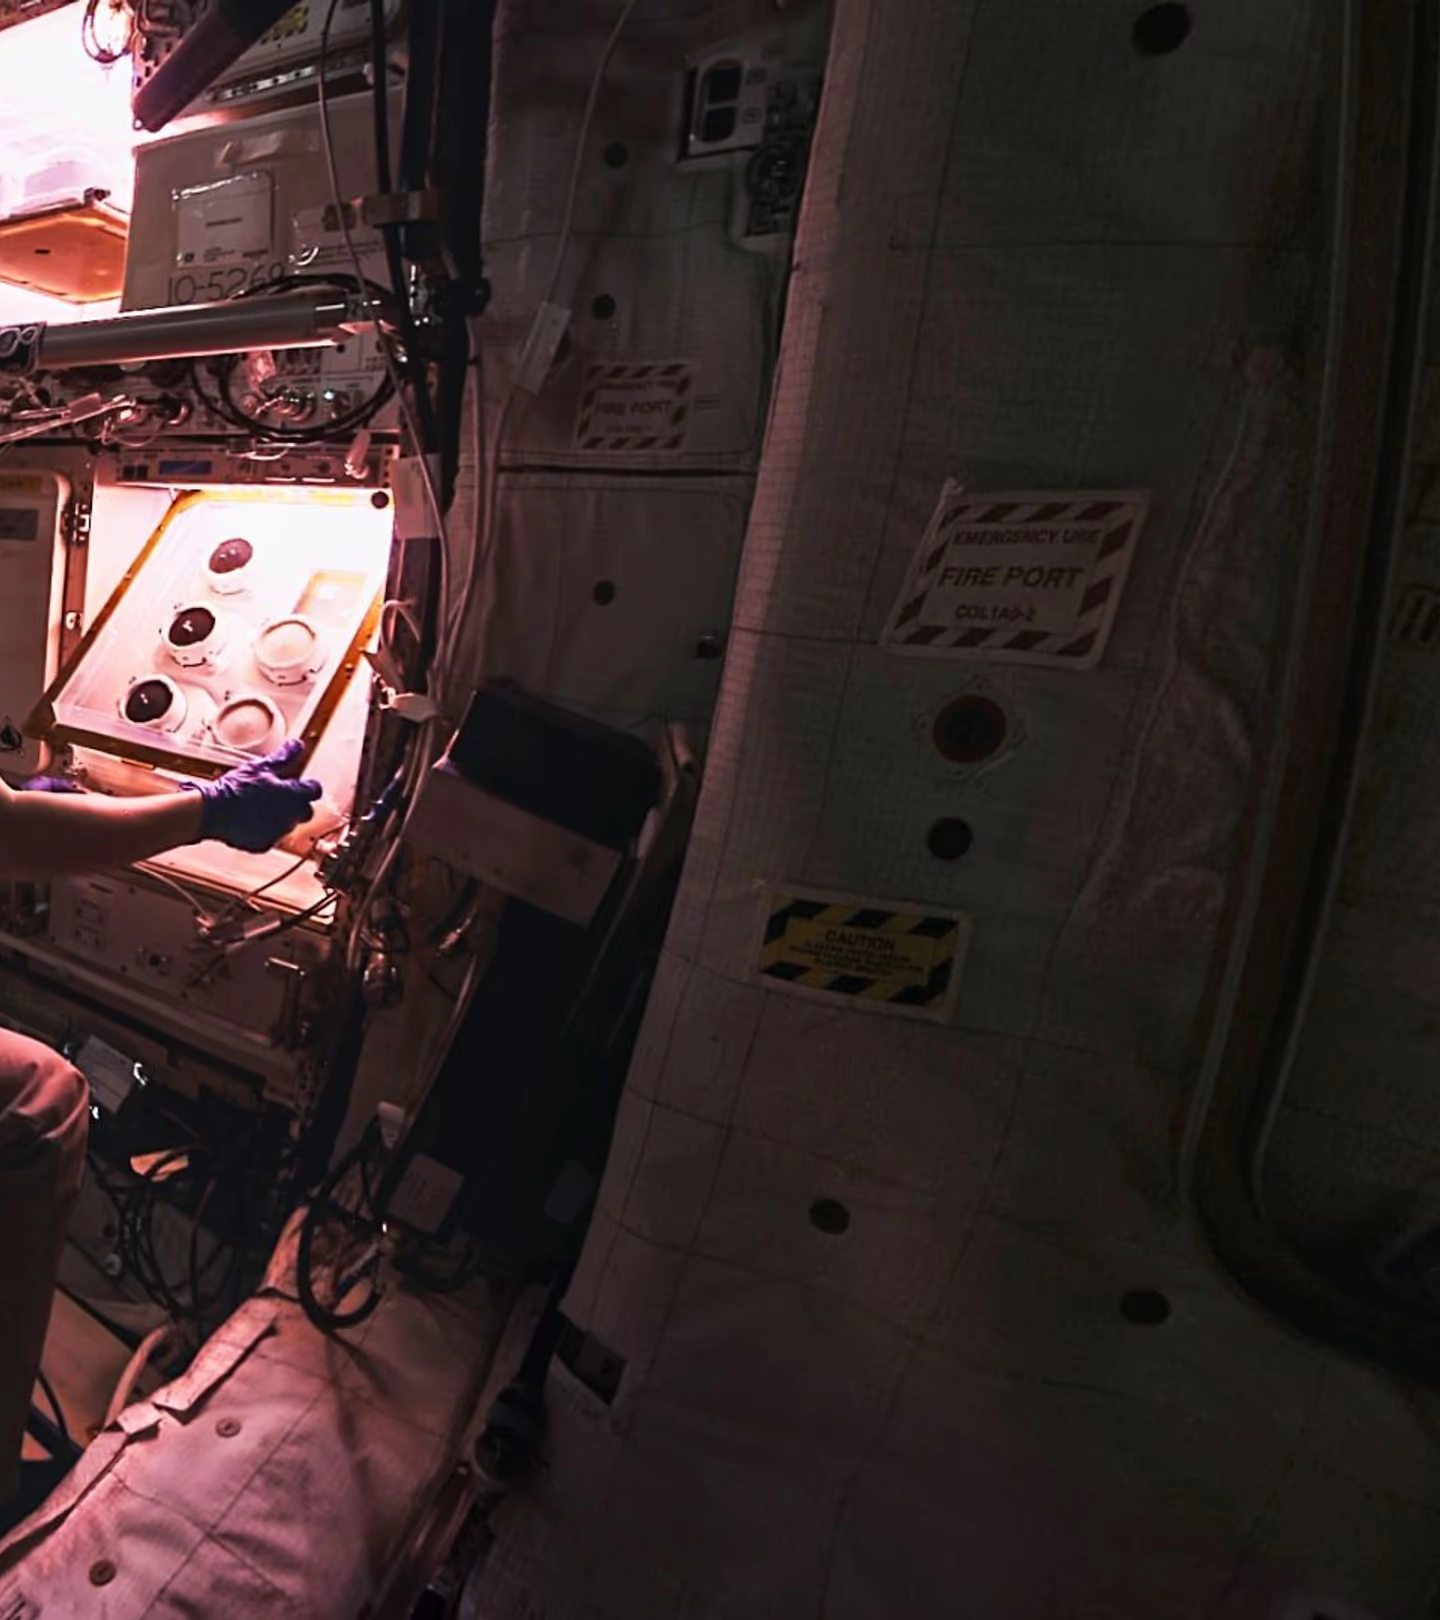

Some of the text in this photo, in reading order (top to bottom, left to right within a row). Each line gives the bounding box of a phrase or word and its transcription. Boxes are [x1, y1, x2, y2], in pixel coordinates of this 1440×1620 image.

[952, 529, 1058, 547] EMERGENCY
[937, 565, 1084, 589] FIRE PORT
[824, 928, 897, 951] CAUTION
